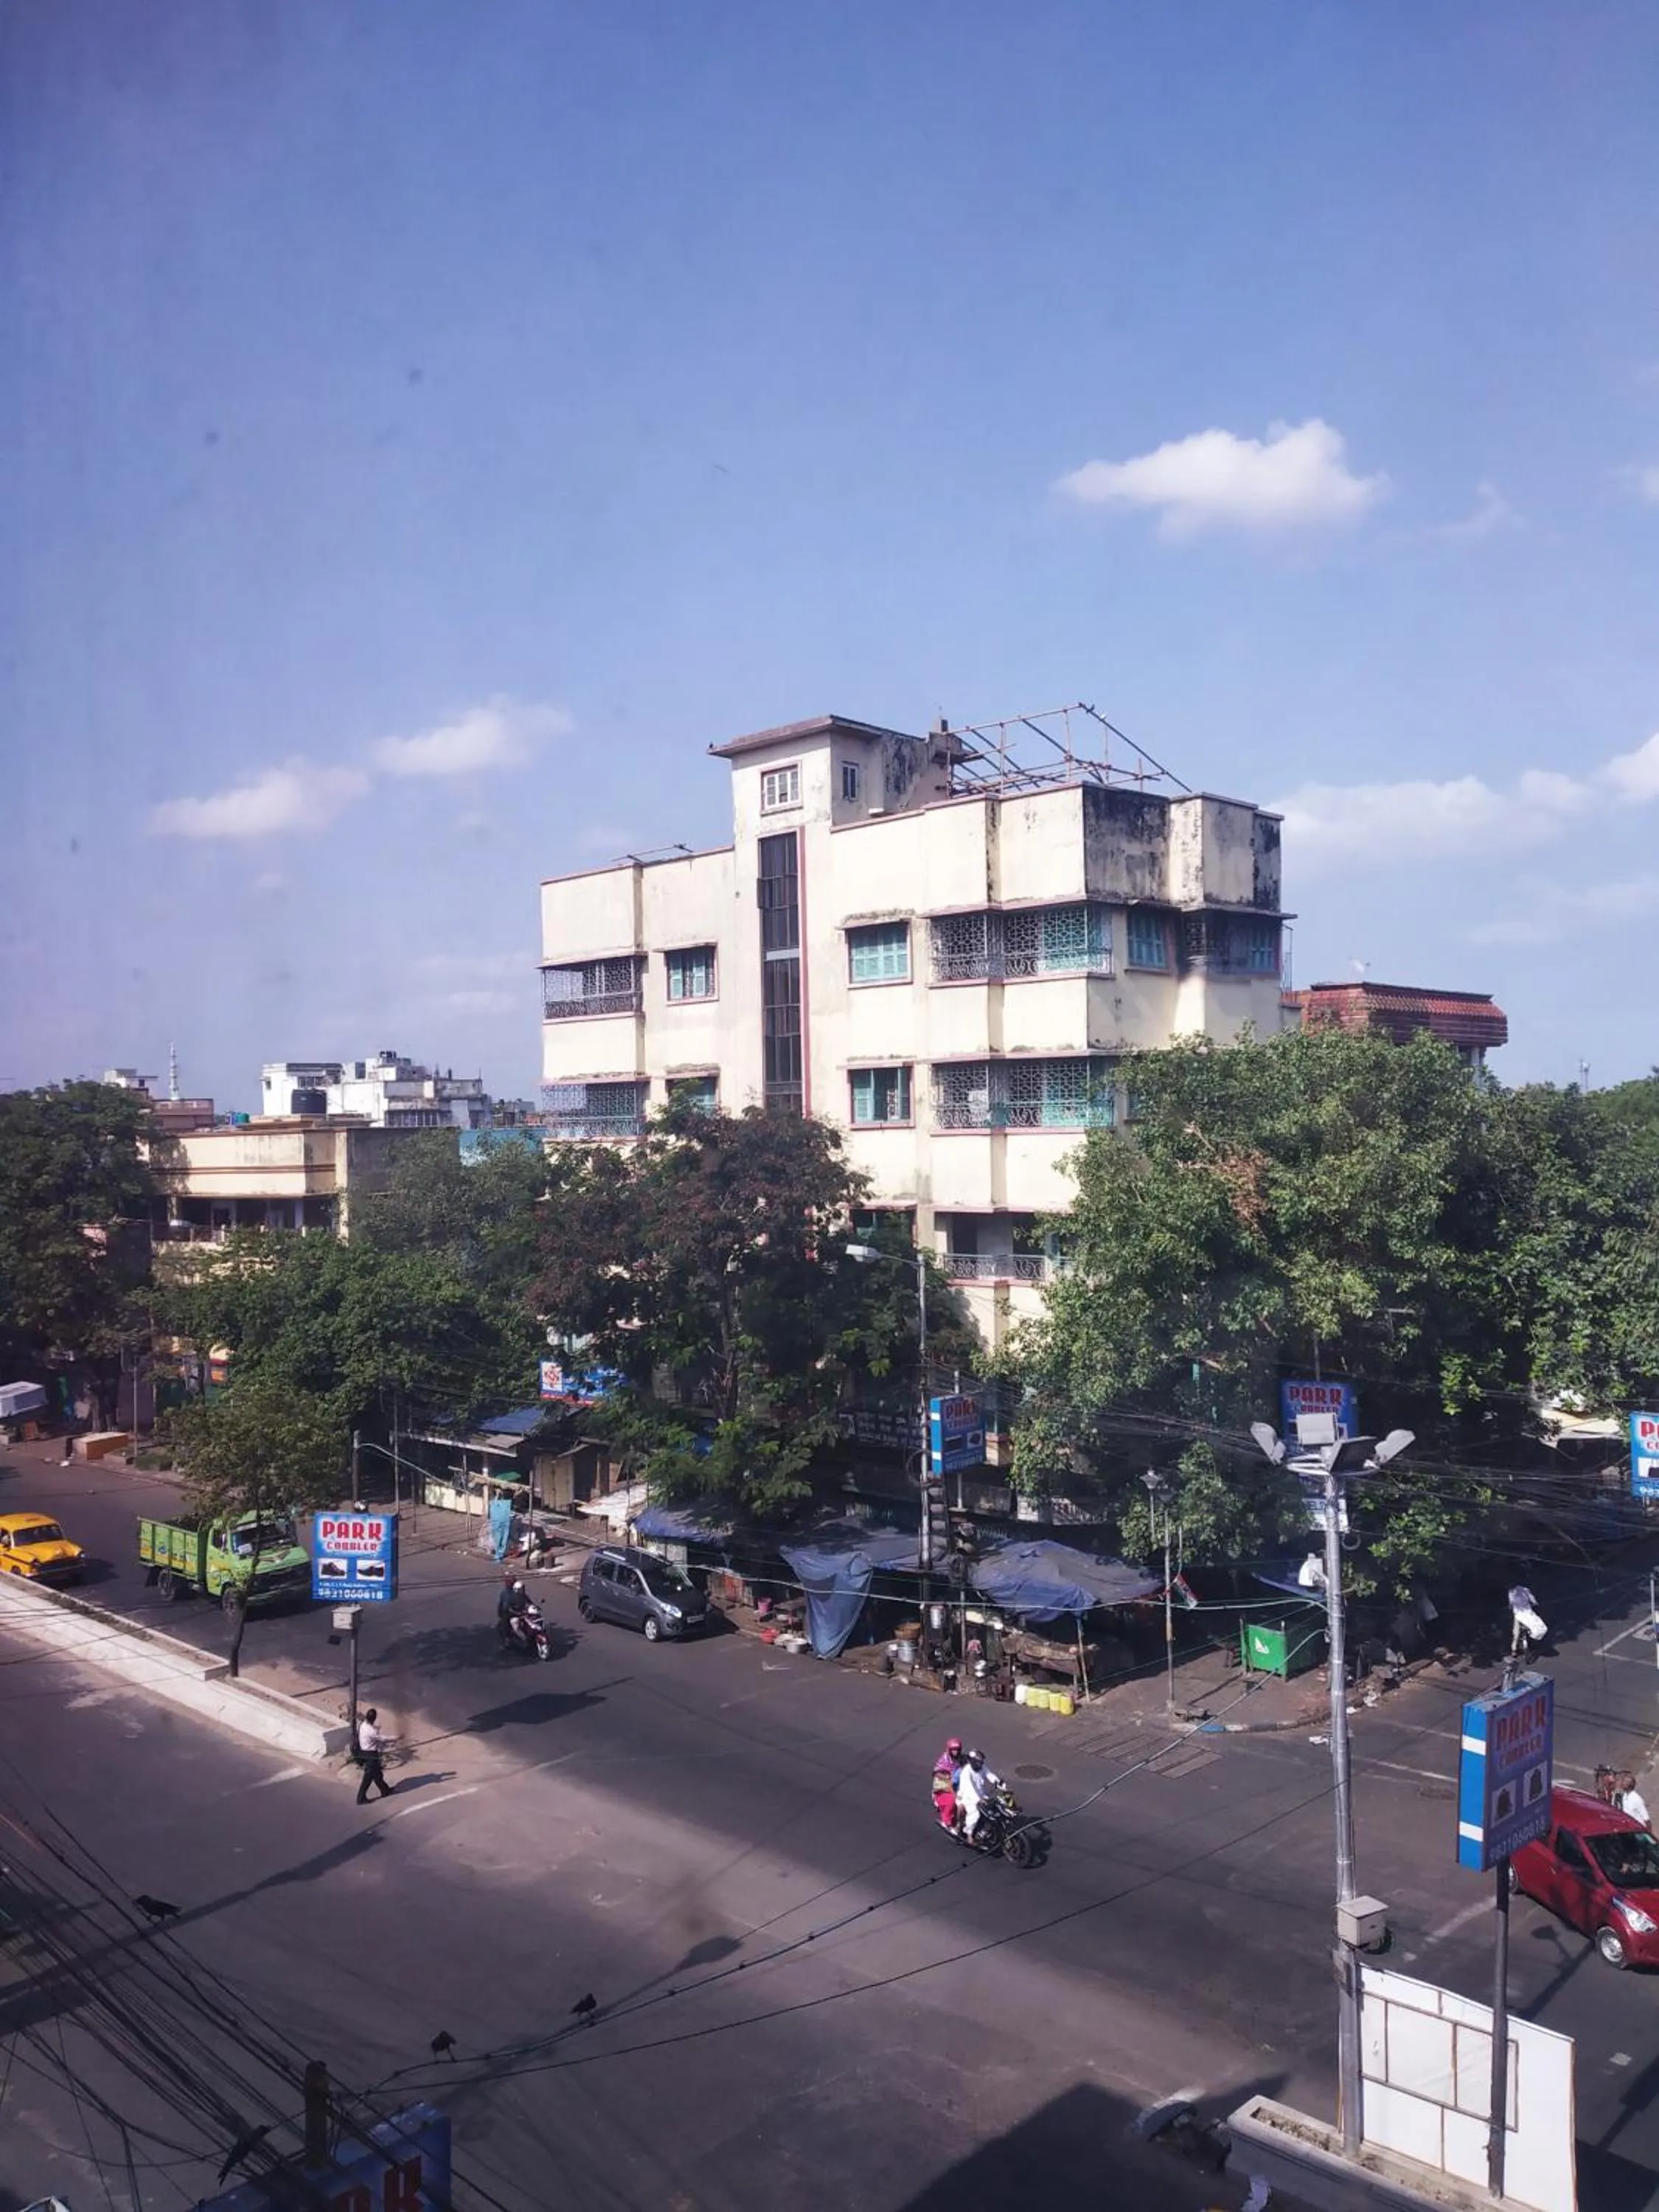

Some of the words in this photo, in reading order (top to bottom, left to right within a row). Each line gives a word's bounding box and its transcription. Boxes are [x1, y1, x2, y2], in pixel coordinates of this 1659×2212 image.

[1290, 1386, 1341, 1405] PARK
[322, 1521, 382, 1541] PARK
[327, 1541, 378, 1551] COBBLER
[1497, 1696, 1546, 1751] PARK
